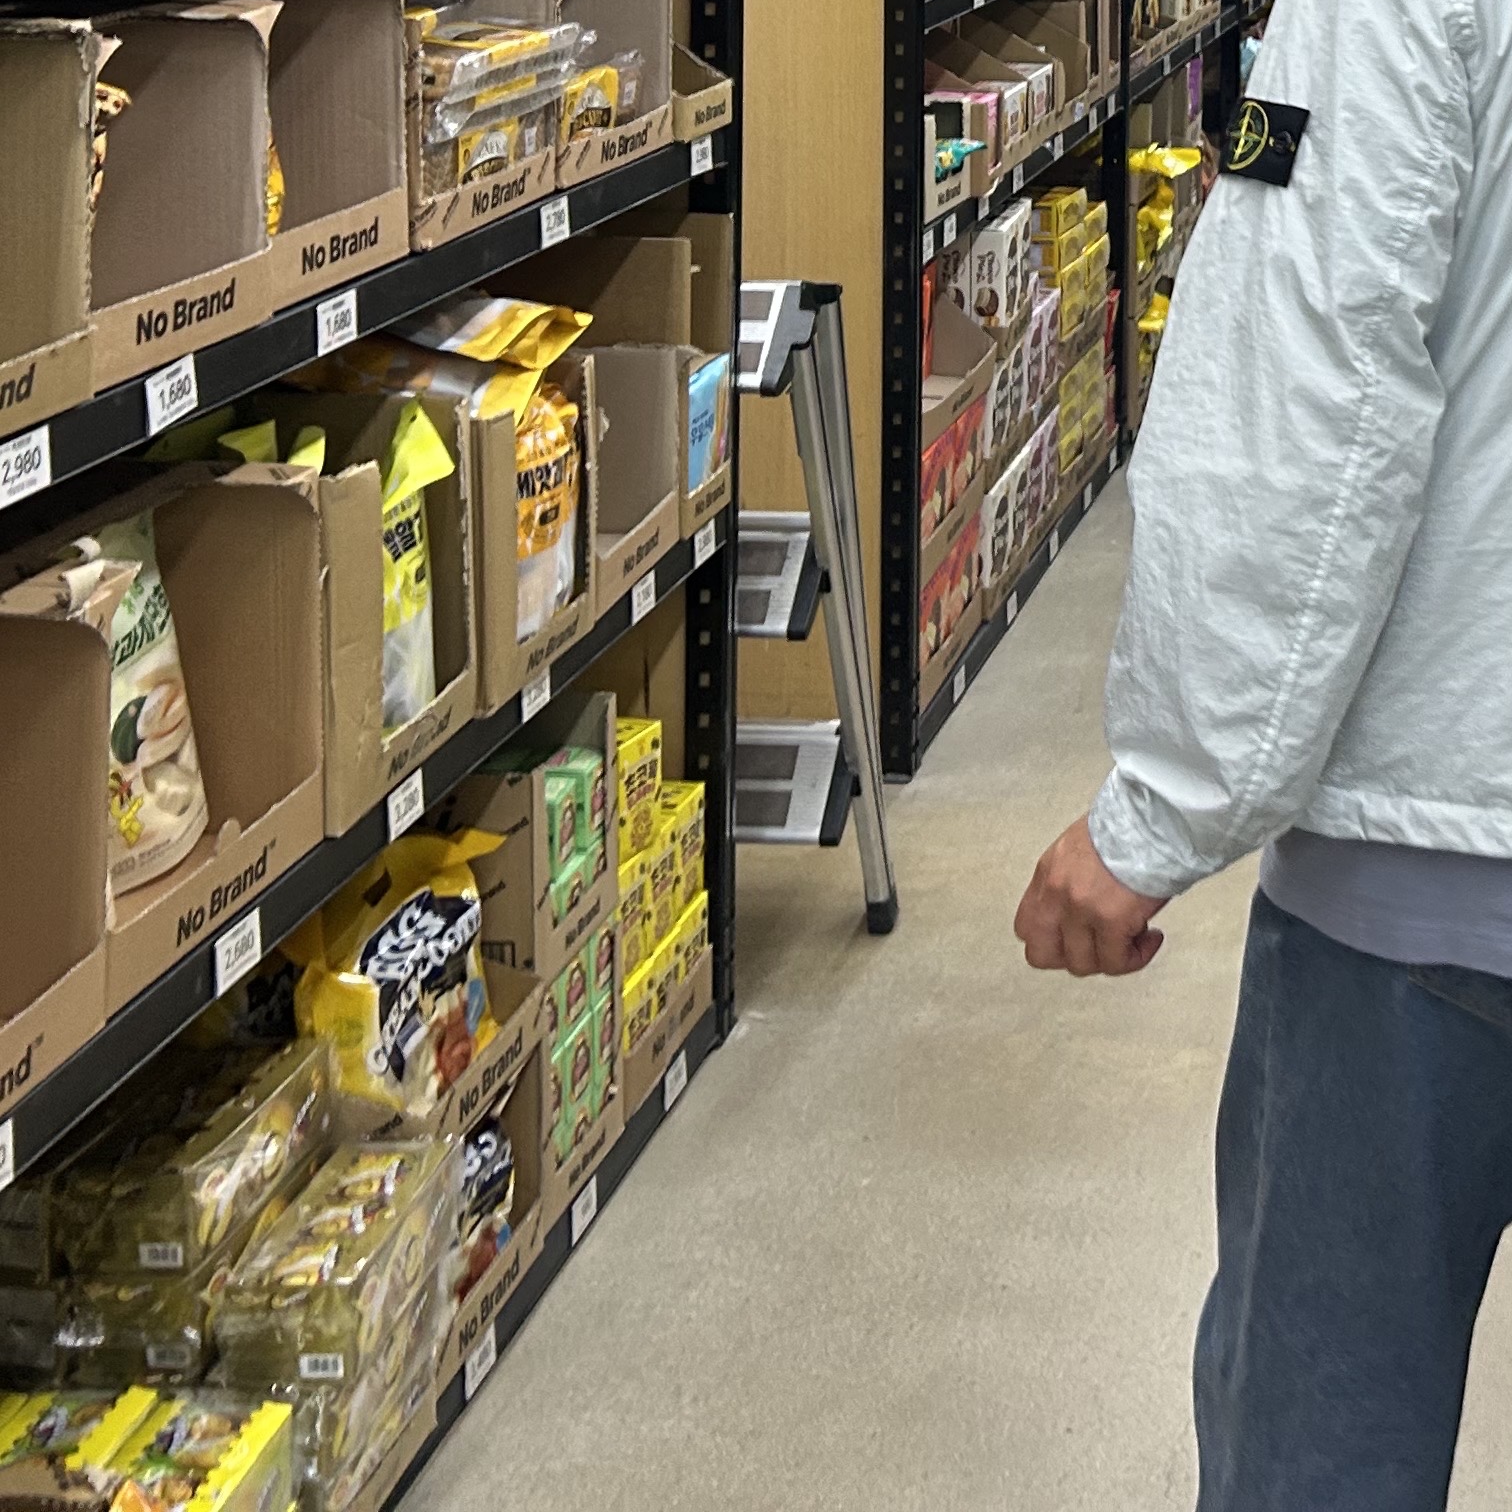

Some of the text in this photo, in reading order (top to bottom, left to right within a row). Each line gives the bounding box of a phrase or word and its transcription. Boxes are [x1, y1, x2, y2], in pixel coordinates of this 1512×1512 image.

[705, 99, 726, 124] Brand
[601, 138, 615, 164] No
[472, 190, 489, 218] No
[301, 216, 379, 276] No Brand
[135, 278, 238, 346] No Brand
[1, 444, 42, 485] 2,980
[527, 616, 578, 674] No Brand
[176, 848, 269, 948] No Brand
[458, 1033, 523, 1124] No Brand
[457, 1252, 522, 1358] No Brand
